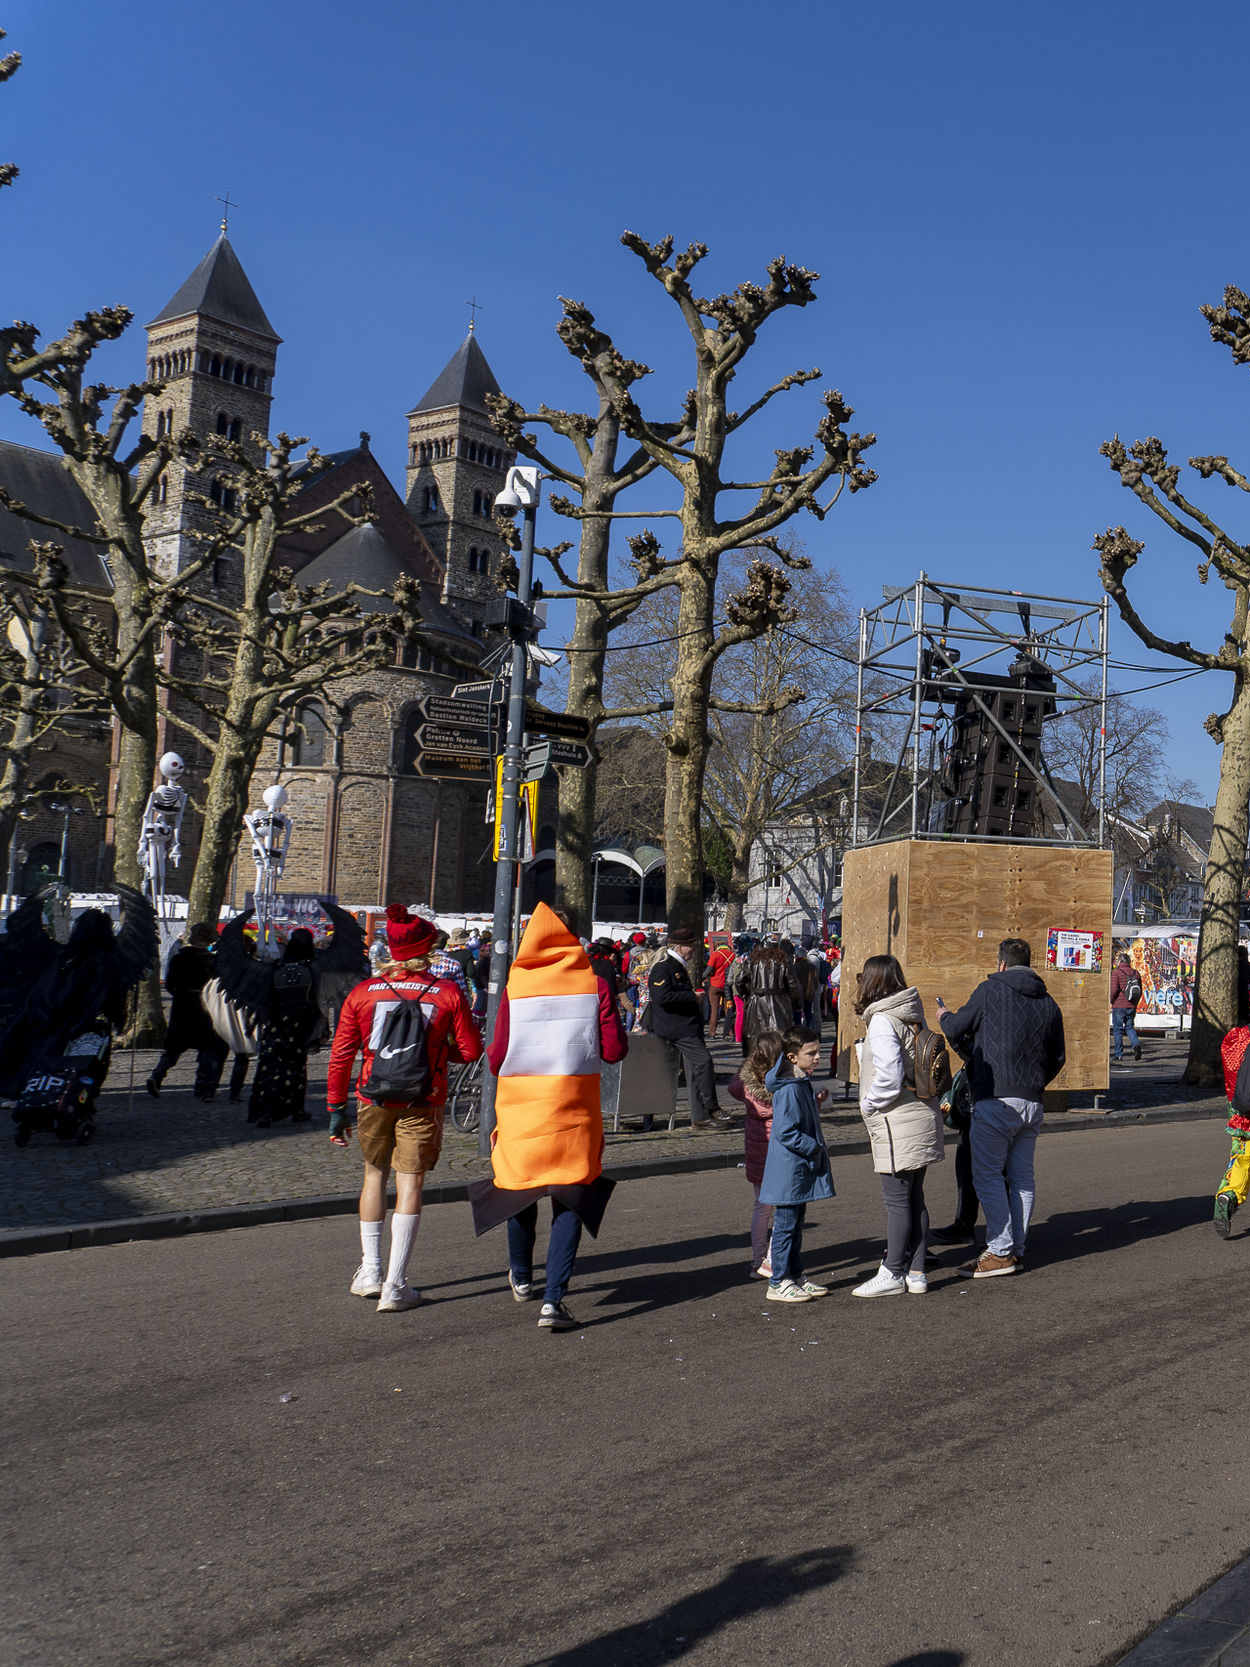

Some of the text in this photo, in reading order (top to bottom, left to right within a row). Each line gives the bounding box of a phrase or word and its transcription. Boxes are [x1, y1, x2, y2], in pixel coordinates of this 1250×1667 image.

[430, 698, 487, 712] Stadsomwalling
[429, 711, 487, 724] Bastion Waldeck
[425, 733, 454, 742] Grotten
[448, 742, 463, 750] Eyck
[424, 754, 454, 762] Museum
[551, 749, 576, 758] Stadhuis
[459, 763, 486, 771] Vrijthof
[293, 898, 319, 914] WC
[25, 1075, 65, 1092] RIP
